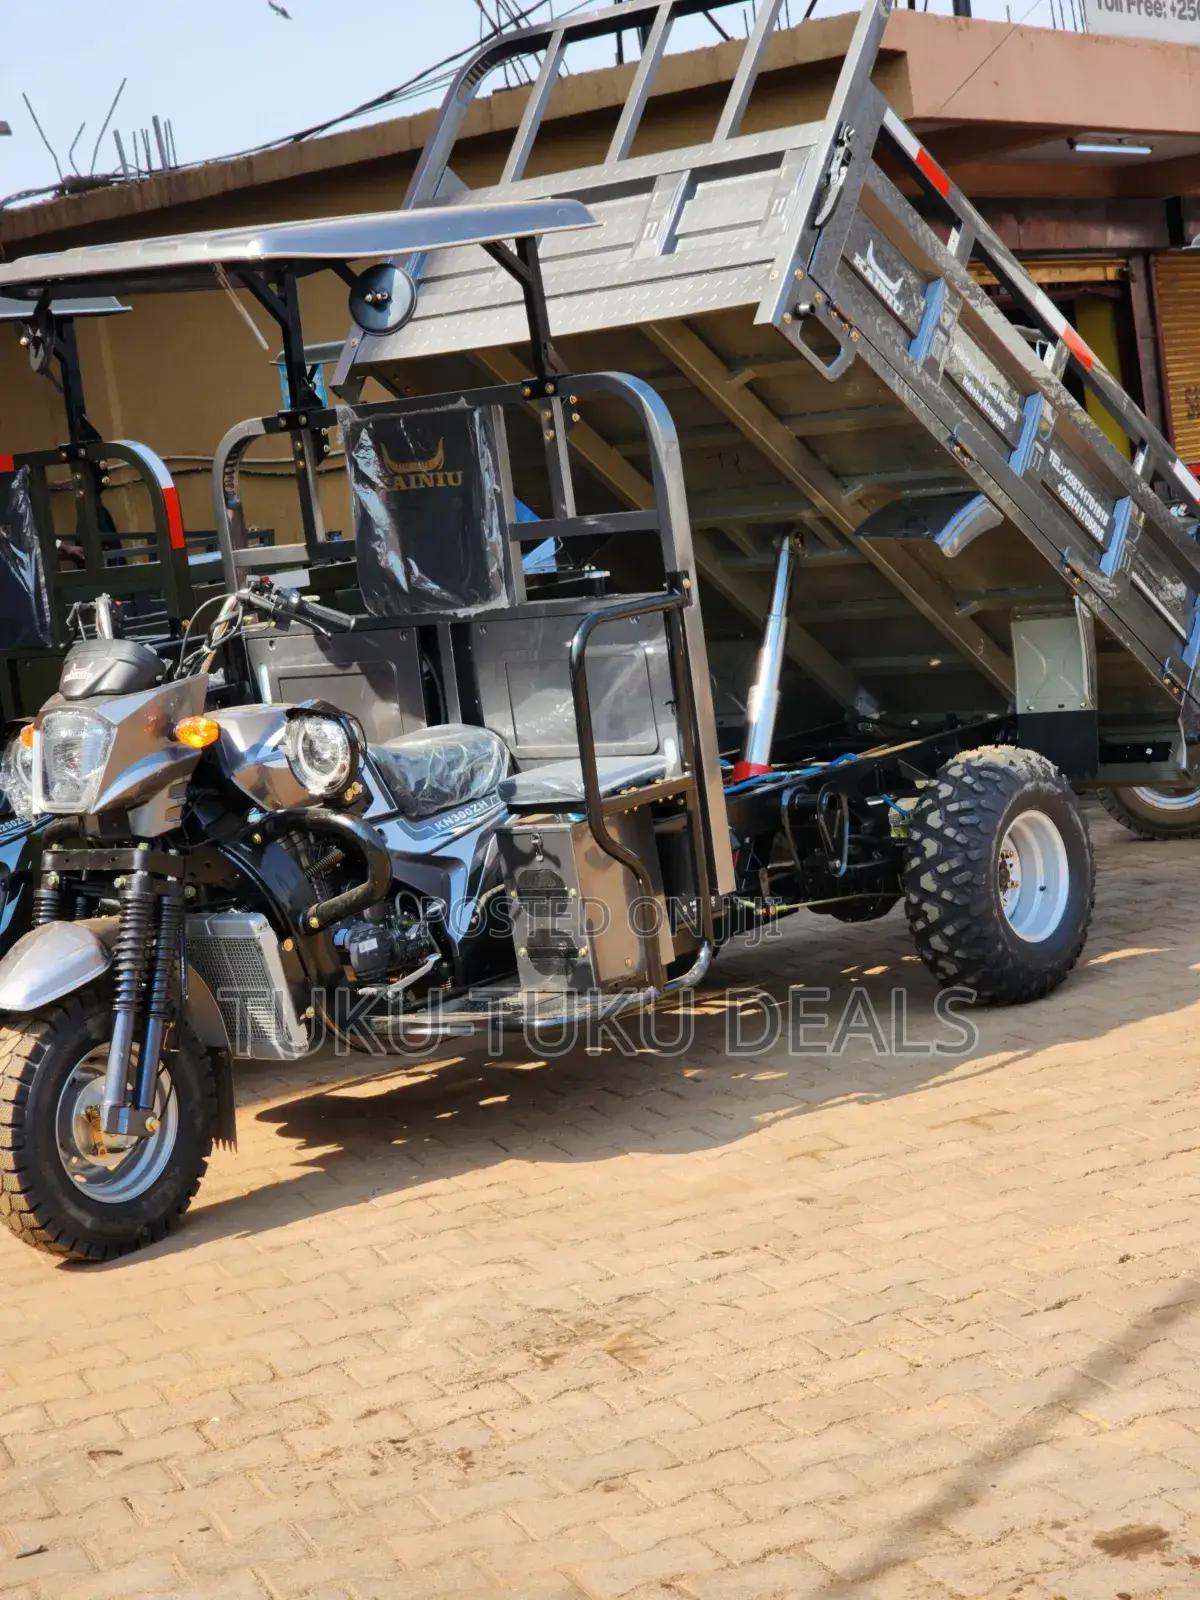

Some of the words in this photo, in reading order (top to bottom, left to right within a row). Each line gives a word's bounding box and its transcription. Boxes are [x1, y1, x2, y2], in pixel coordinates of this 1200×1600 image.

[1126, 0, 1167, 19] Free:
[380, 470, 463, 492] AINIU
[0, 815, 29, 832] 250ZH
[434, 800, 489, 831] KN300ZH
